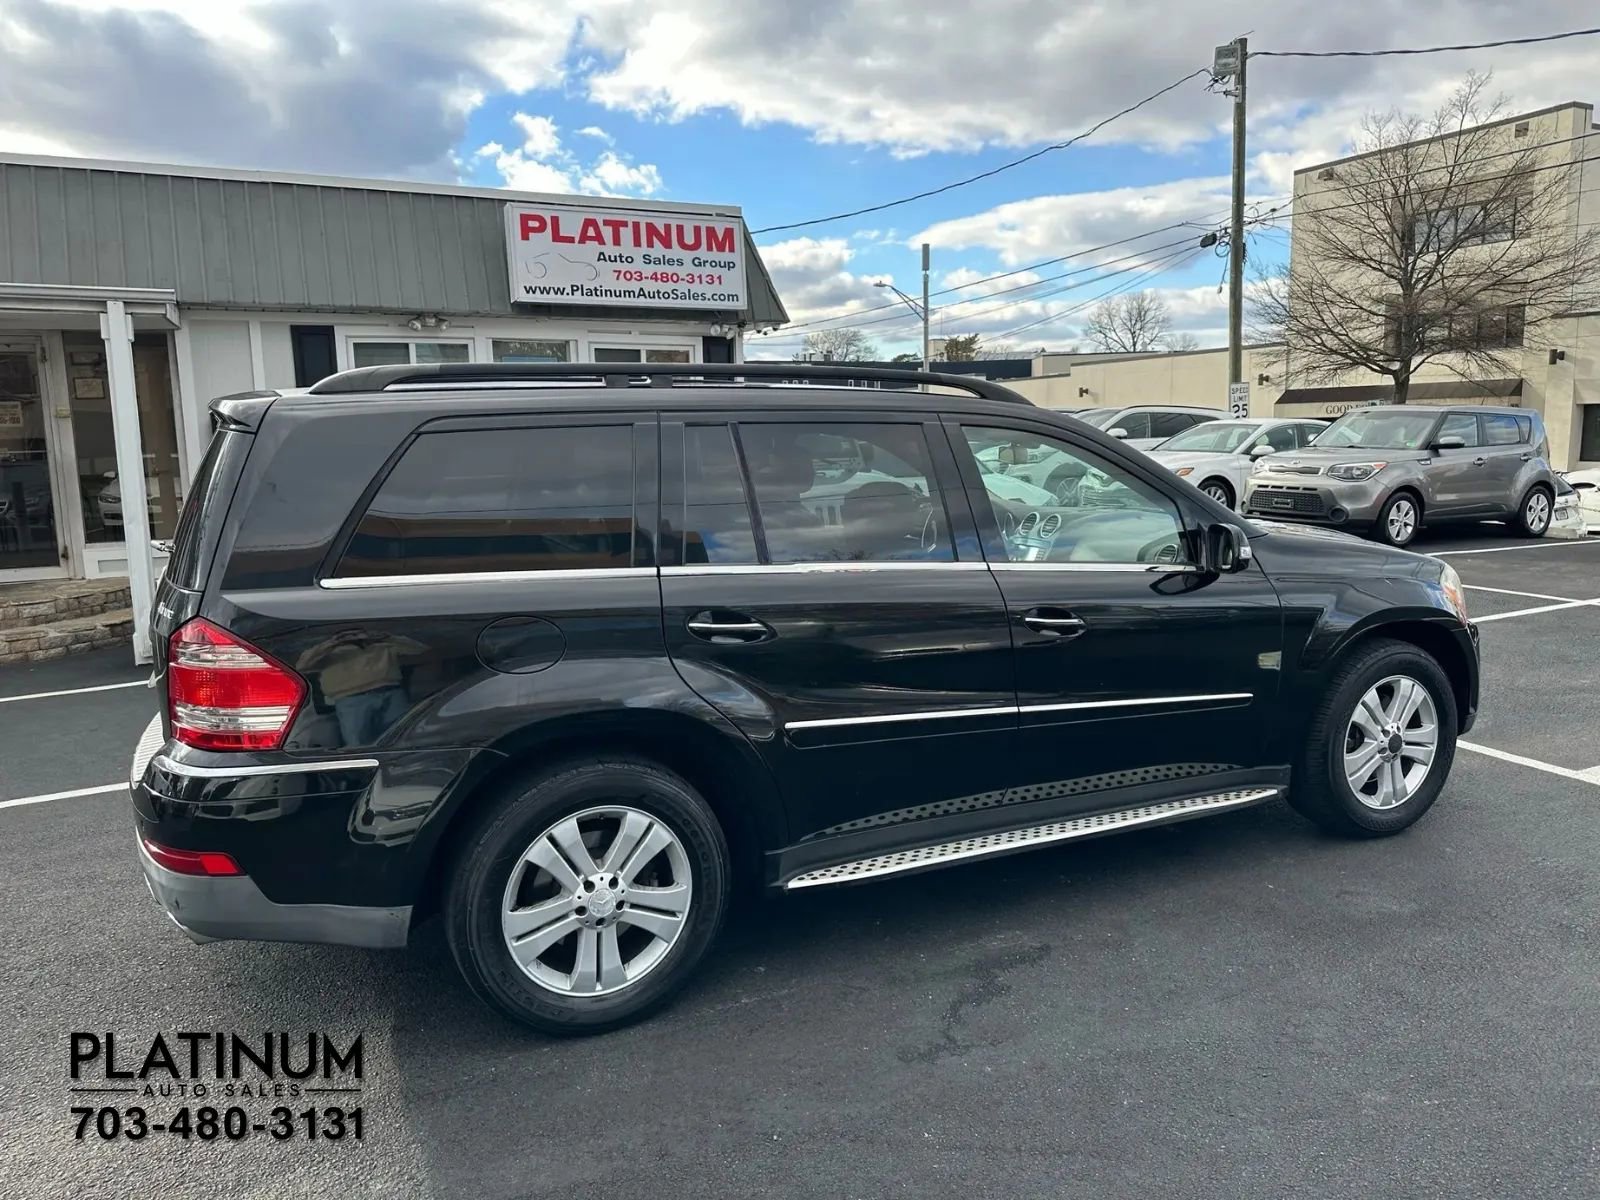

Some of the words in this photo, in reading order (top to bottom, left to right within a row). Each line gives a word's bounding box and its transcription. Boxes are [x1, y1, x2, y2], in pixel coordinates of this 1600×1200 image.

[520, 213, 735, 253] PLATINUM
[597, 252, 634, 264] Auto
[642, 254, 684, 267] Sales
[692, 257, 736, 271] Group
[613, 270, 723, 286] 703-480-3131
[524, 284, 739, 303] www.PlatinumAutoSales.com
[1231, 387, 1248, 395] SPEED
[1233, 395, 1247, 403] LIMIT
[1232, 403, 1248, 419] 25
